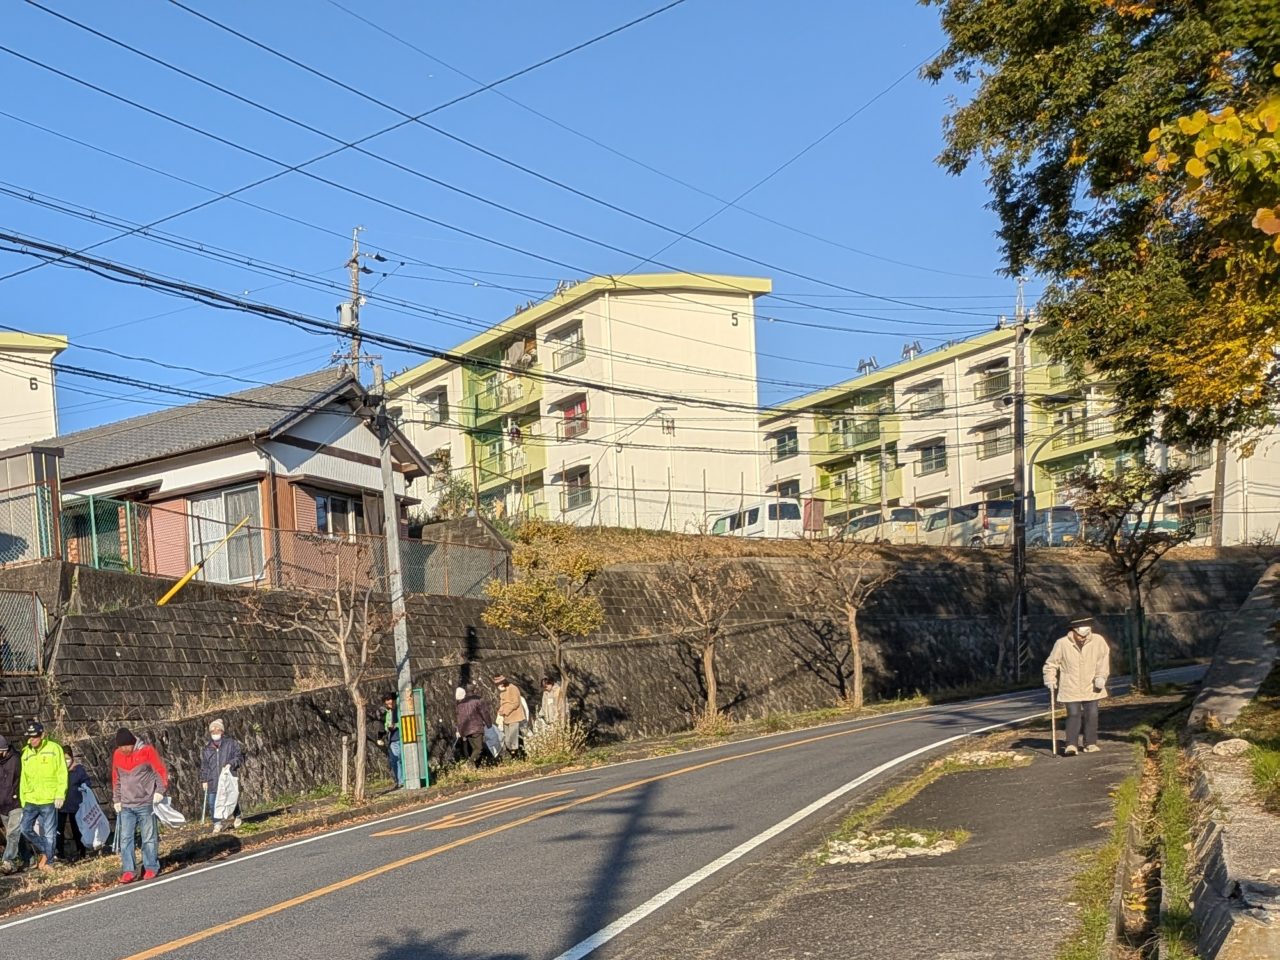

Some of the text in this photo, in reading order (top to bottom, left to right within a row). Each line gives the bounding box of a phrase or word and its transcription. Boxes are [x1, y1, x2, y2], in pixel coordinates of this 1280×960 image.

[731, 312, 739, 327] 5
[29, 376, 39, 391] 6
[368, 789, 576, 838] 30
